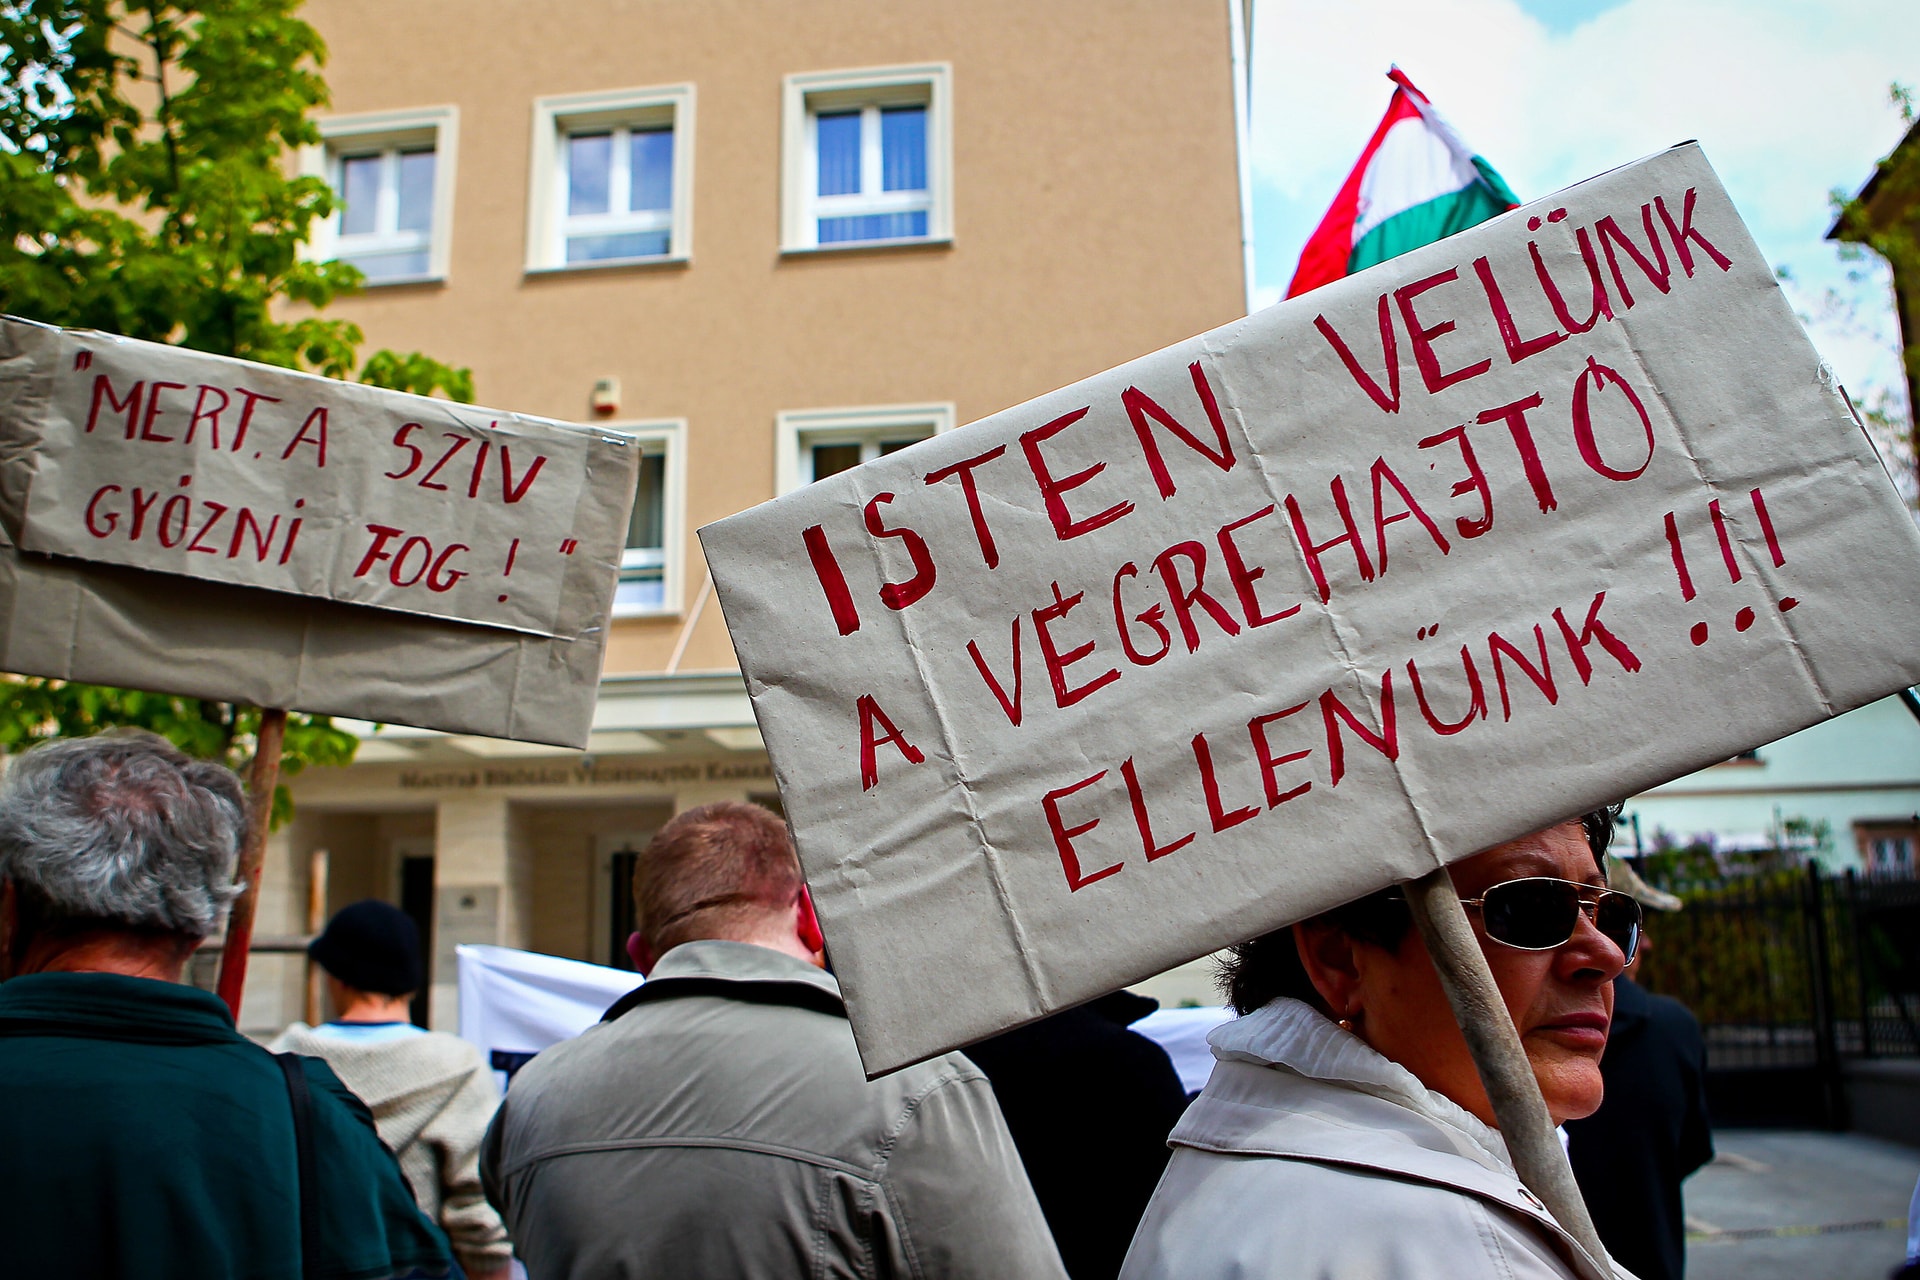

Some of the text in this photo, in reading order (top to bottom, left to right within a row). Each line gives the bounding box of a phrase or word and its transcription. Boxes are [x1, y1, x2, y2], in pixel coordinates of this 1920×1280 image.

[281, 405, 330, 470] A
[802, 187, 1733, 636] ISTEN VELÜNK
[856, 693, 927, 793] A
[1041, 589, 1643, 894] ELLENÜNK
